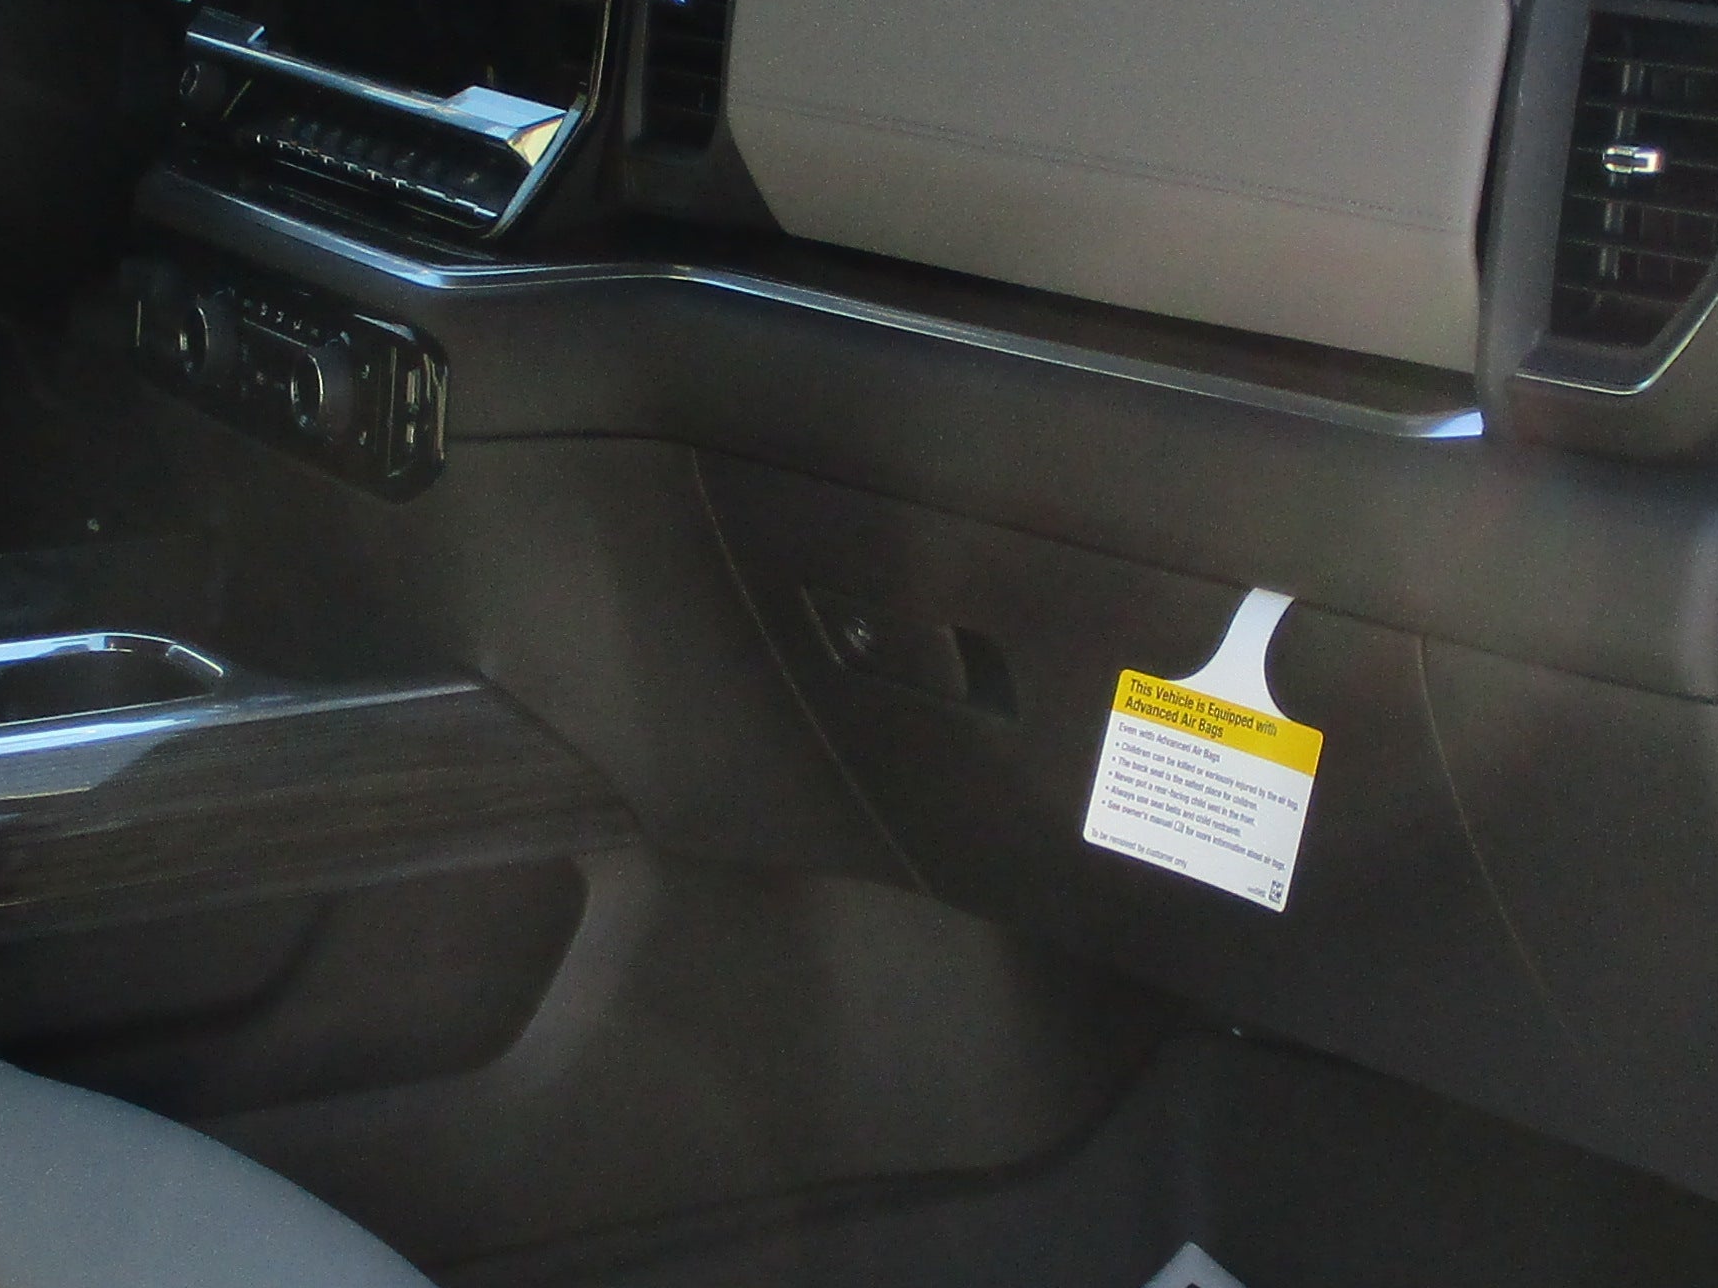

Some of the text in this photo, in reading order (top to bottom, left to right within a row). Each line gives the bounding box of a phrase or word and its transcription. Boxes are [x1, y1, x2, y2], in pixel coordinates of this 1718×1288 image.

[1125, 695, 1223, 738] Advanced Air Bags
[1130, 679, 1277, 735] This Vehicle is Equipped with
[1119, 722, 1220, 762] Even with Advanced Air Bags
[1119, 757, 1130, 766] The
[1132, 761, 1147, 770] back
[1150, 768, 1163, 776] seat
[1173, 775, 1182, 783] the
[1205, 787, 1221, 796] place
[1122, 742, 1150, 756] Children
[1153, 753, 1163, 761] can
[1167, 757, 1174, 765] be
[1177, 760, 1194, 770] killed
[1236, 781, 1256, 793] injured
[1258, 788, 1265, 798] by
[1267, 791, 1276, 800] the
[1111, 786, 1134, 799] Always
[1137, 795, 1147, 803] use
[1150, 800, 1163, 808] seat
[1166, 804, 1180, 814] belts
[1183, 810, 1194, 819] and
[1196, 814, 1210, 824] child
[1115, 771, 1133, 782] Never
[1136, 779, 1146, 788] put
[1191, 796, 1205, 806] child
[1229, 810, 1238, 818] the
[1092, 828, 1098, 836] To
[1109, 835, 1135, 848] removed
[1137, 845, 1144, 853] by
[1108, 800, 1120, 810] See
[1150, 815, 1172, 827] manual
[1196, 831, 1210, 840] more
[1213, 836, 1245, 853] information
